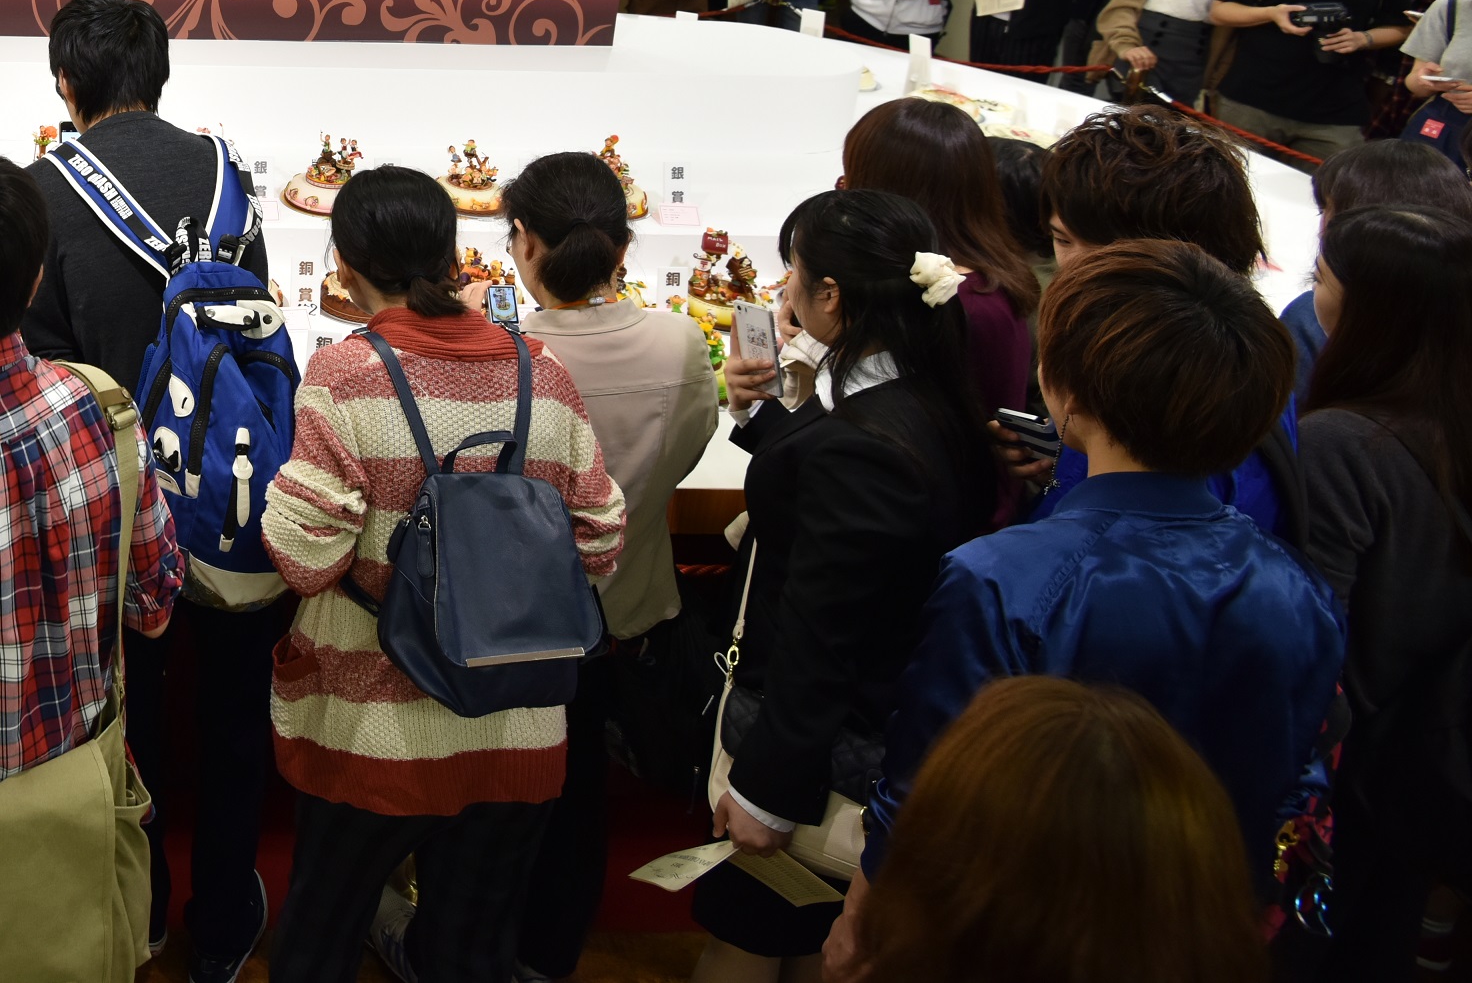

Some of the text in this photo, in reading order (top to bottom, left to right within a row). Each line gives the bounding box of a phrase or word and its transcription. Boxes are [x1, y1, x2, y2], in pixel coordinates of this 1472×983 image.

[67, 153, 94, 177] ZERO
[254, 161, 268, 198] 銀賞
[671, 167, 685, 204] 銀賞
[298, 261, 314, 302] 銅賞
